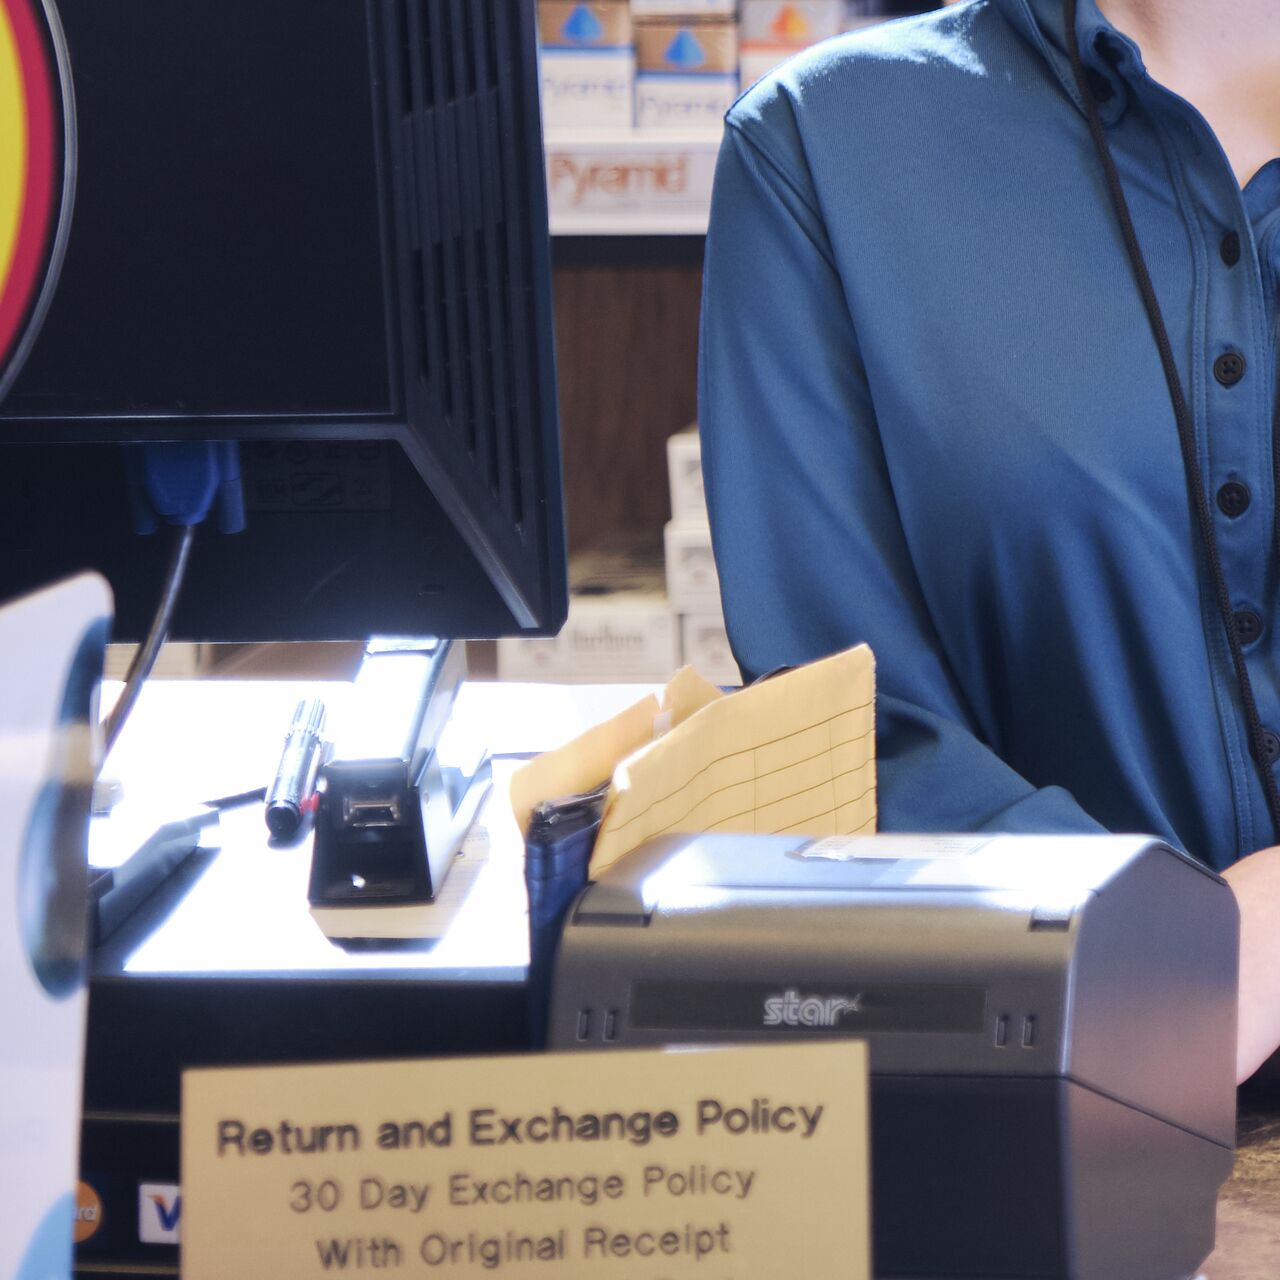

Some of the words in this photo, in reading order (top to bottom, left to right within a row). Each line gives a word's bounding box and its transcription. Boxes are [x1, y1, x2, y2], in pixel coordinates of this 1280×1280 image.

[548, 151, 689, 207] Pyramid
[762, 989, 845, 1028] star
[216, 1118, 361, 1157] Return
[377, 1111, 452, 1149] and
[468, 1105, 680, 1147] Exchange
[697, 1098, 823, 1138] Policy
[289, 1179, 341, 1213] 30
[360, 1176, 430, 1215] Day
[449, 1168, 624, 1208] Exchange
[643, 1165, 756, 1200] Policy
[315, 1236, 402, 1271] With
[420, 1227, 565, 1270] Original
[583, 1221, 731, 1259] Receipt
